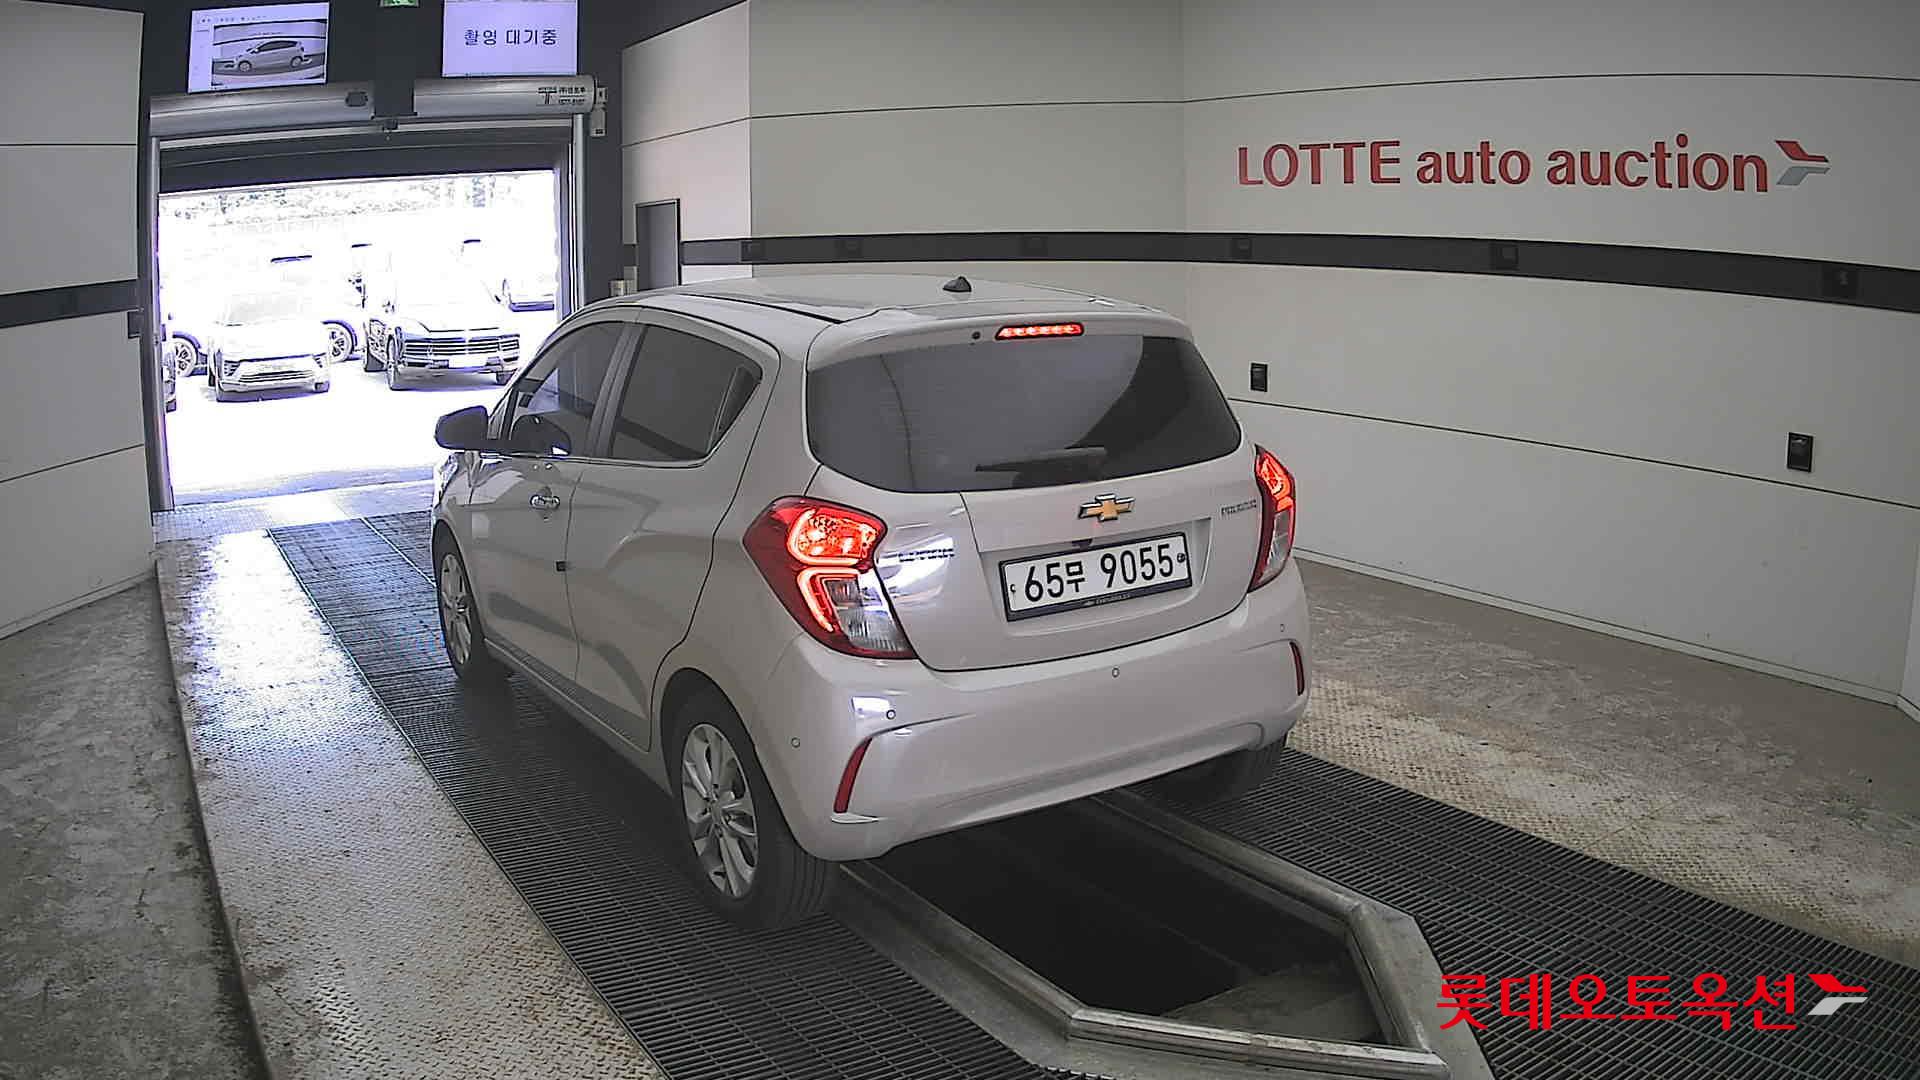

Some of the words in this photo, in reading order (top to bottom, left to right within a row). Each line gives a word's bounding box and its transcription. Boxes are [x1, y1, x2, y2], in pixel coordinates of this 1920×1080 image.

[506, 29, 557, 46] 대기중
[1238, 140, 1400, 187] LOTTE
[1416, 140, 1531, 185] auto
[1547, 133, 1769, 193] auction
[1025, 560, 1086, 602] 65무
[1100, 543, 1173, 589] 9055
